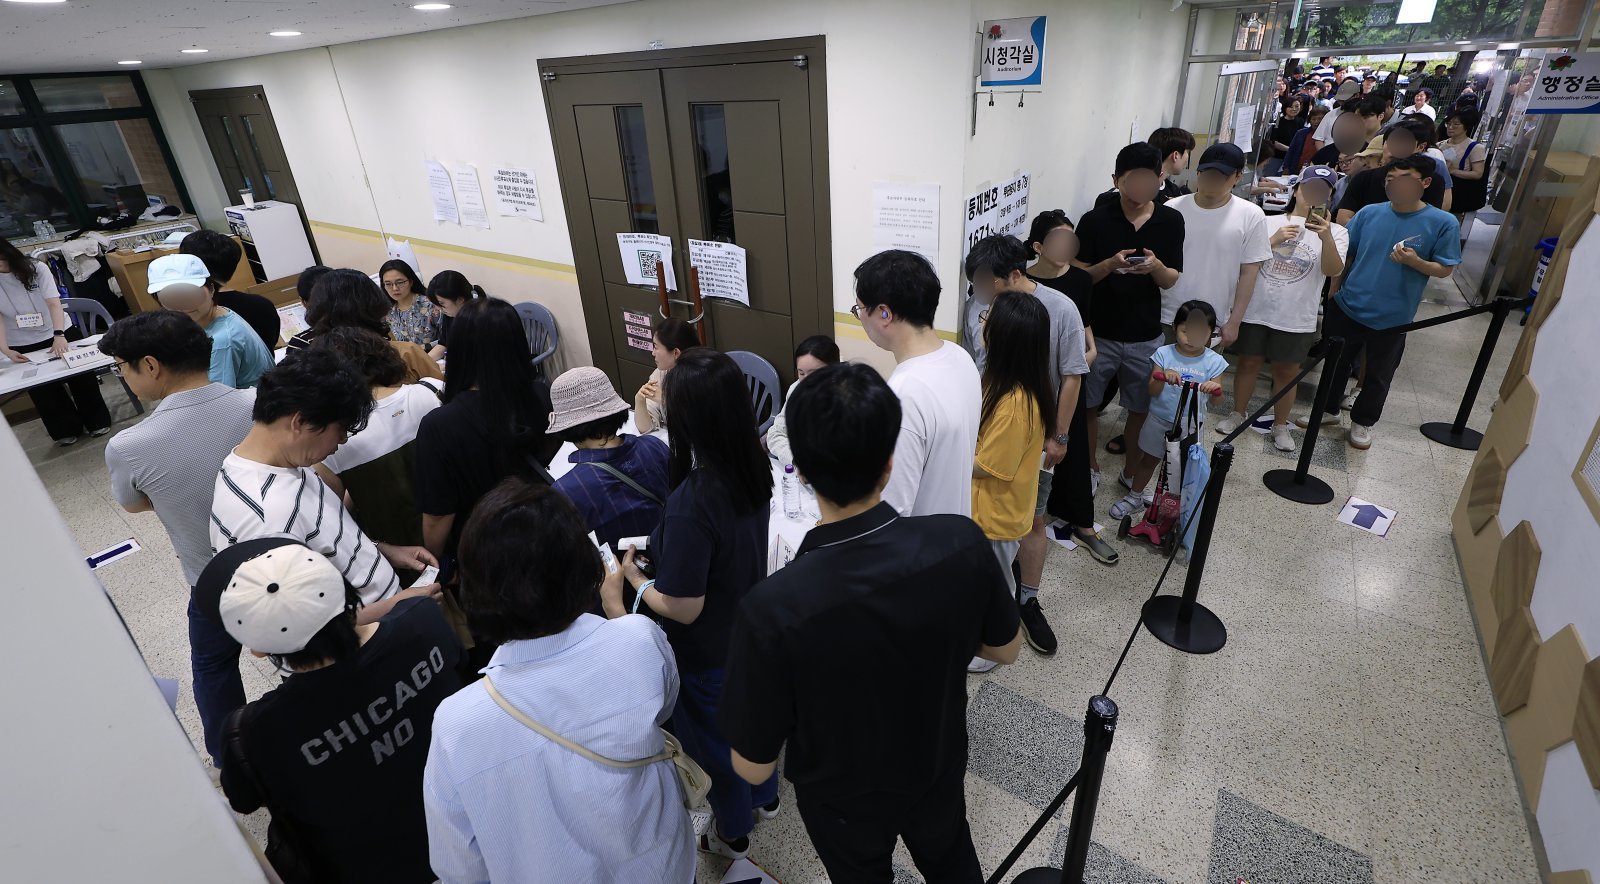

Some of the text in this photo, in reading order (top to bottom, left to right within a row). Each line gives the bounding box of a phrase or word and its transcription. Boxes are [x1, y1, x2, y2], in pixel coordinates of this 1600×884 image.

[984, 45, 1034, 66] 시청각실
[968, 187, 998, 221] 등재번호
[300, 646, 445, 766] CHICAGO
[370, 718, 415, 765] NO
